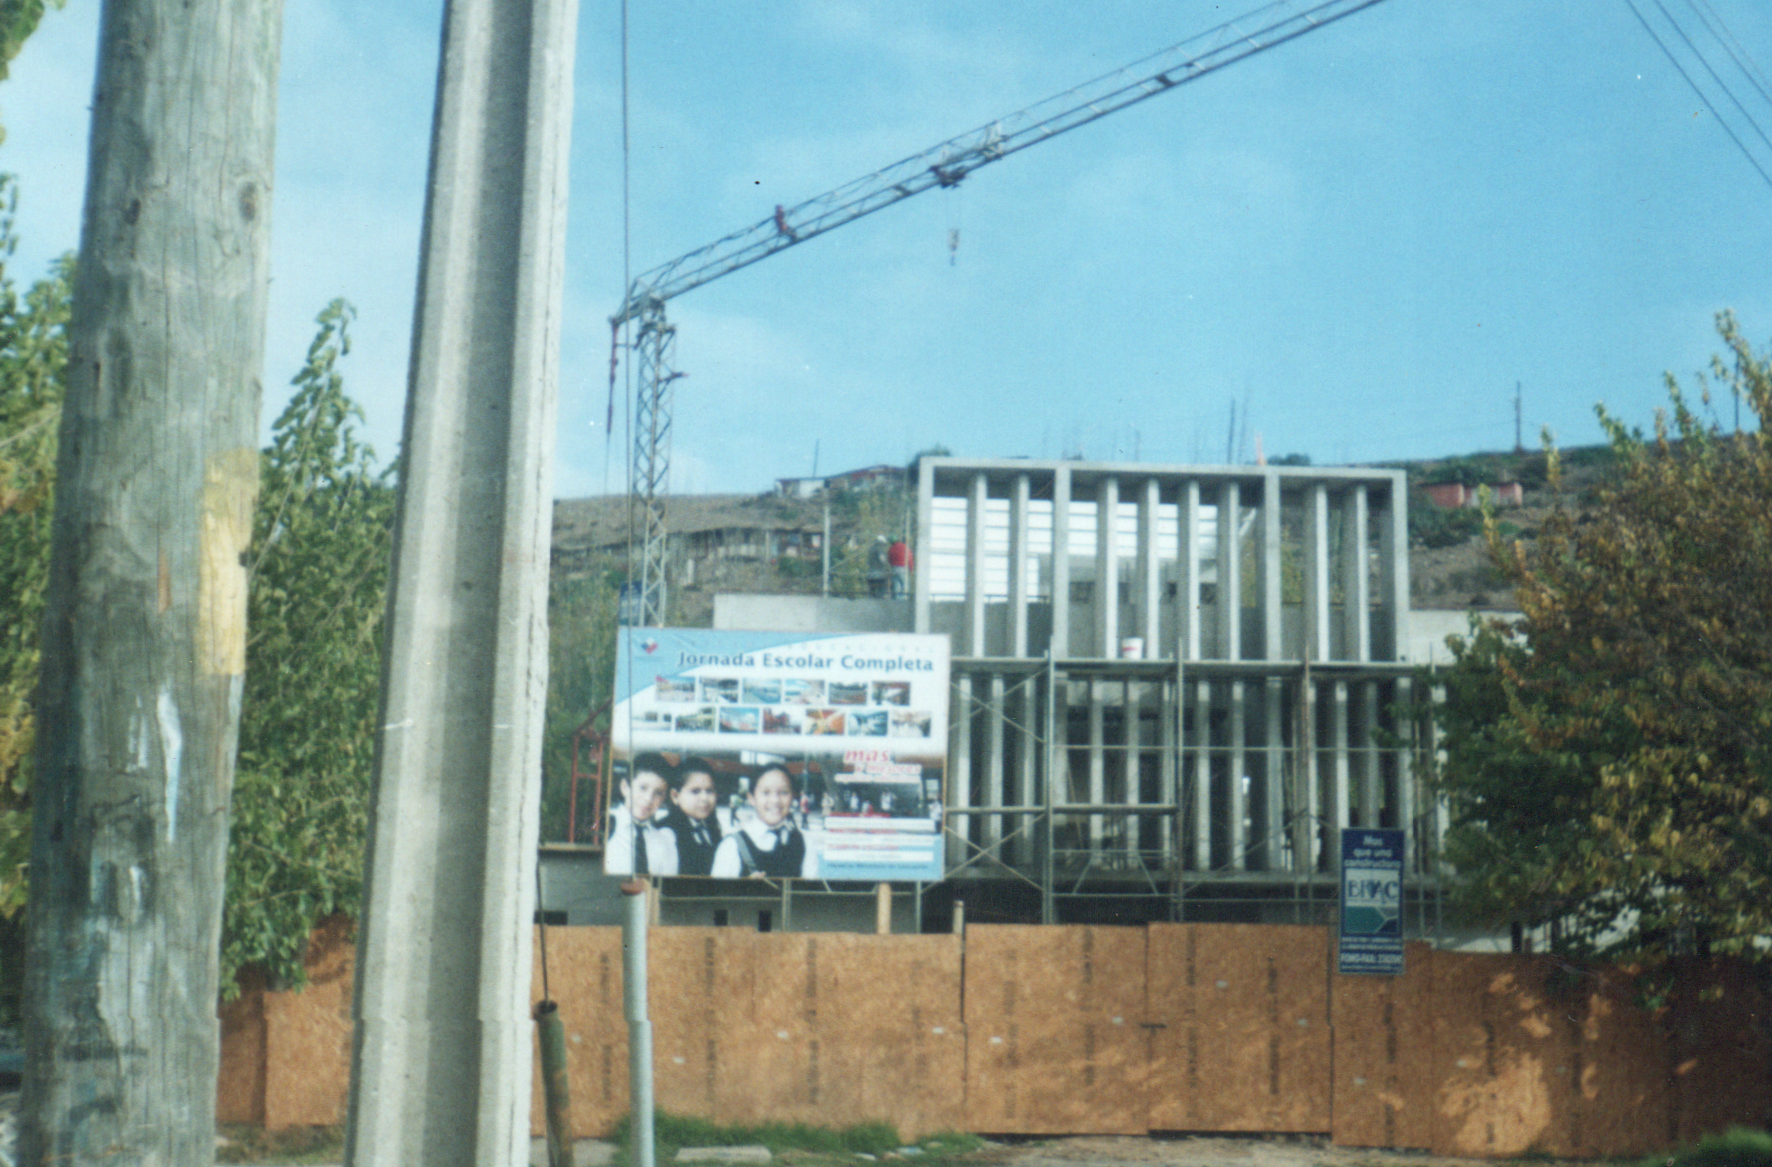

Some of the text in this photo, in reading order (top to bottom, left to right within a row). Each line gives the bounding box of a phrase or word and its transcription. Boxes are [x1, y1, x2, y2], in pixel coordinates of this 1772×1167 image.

[678, 650, 755, 668] Jornada
[762, 653, 834, 669] Escolar
[841, 655, 934, 672] Completa
